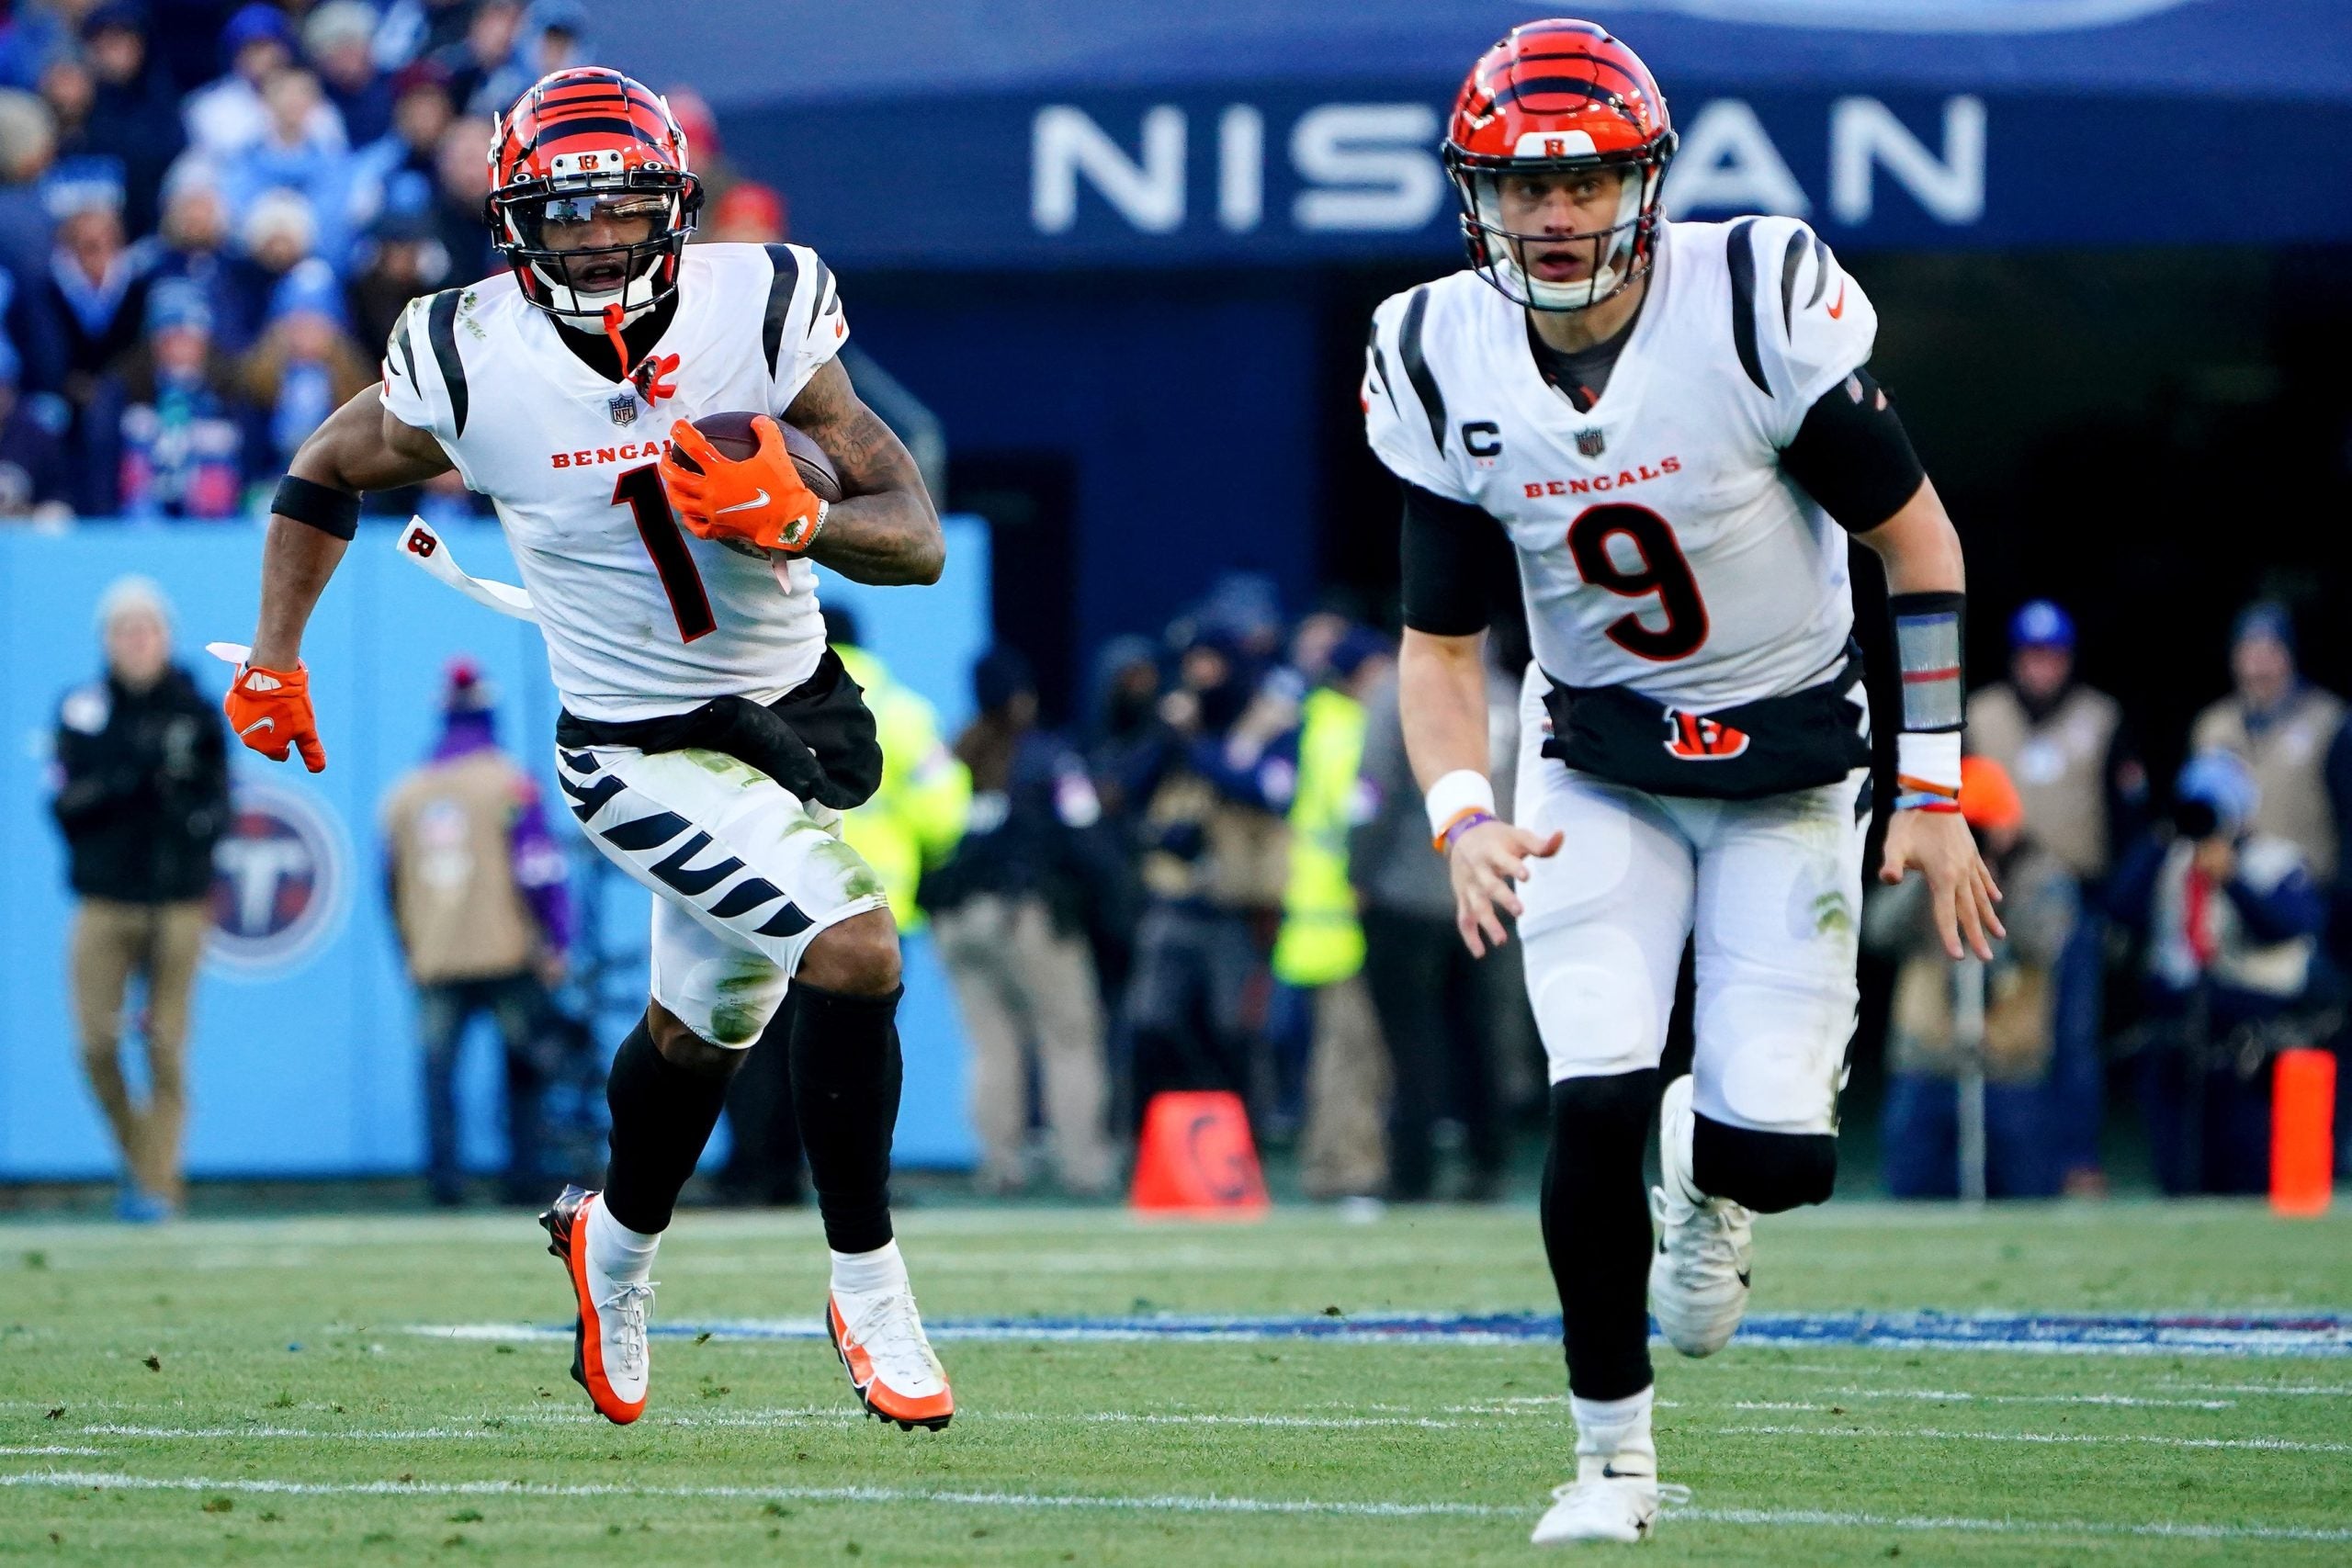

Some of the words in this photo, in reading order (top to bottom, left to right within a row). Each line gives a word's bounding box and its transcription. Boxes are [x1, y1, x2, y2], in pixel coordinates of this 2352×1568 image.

[1031, 96, 1986, 233] NISAN
[551, 439, 673, 468] BENGA
[1462, 422, 1502, 457] C
[1523, 457, 1682, 499] BENGALS
[611, 462, 718, 644] 1
[1567, 502, 1710, 662] 9
